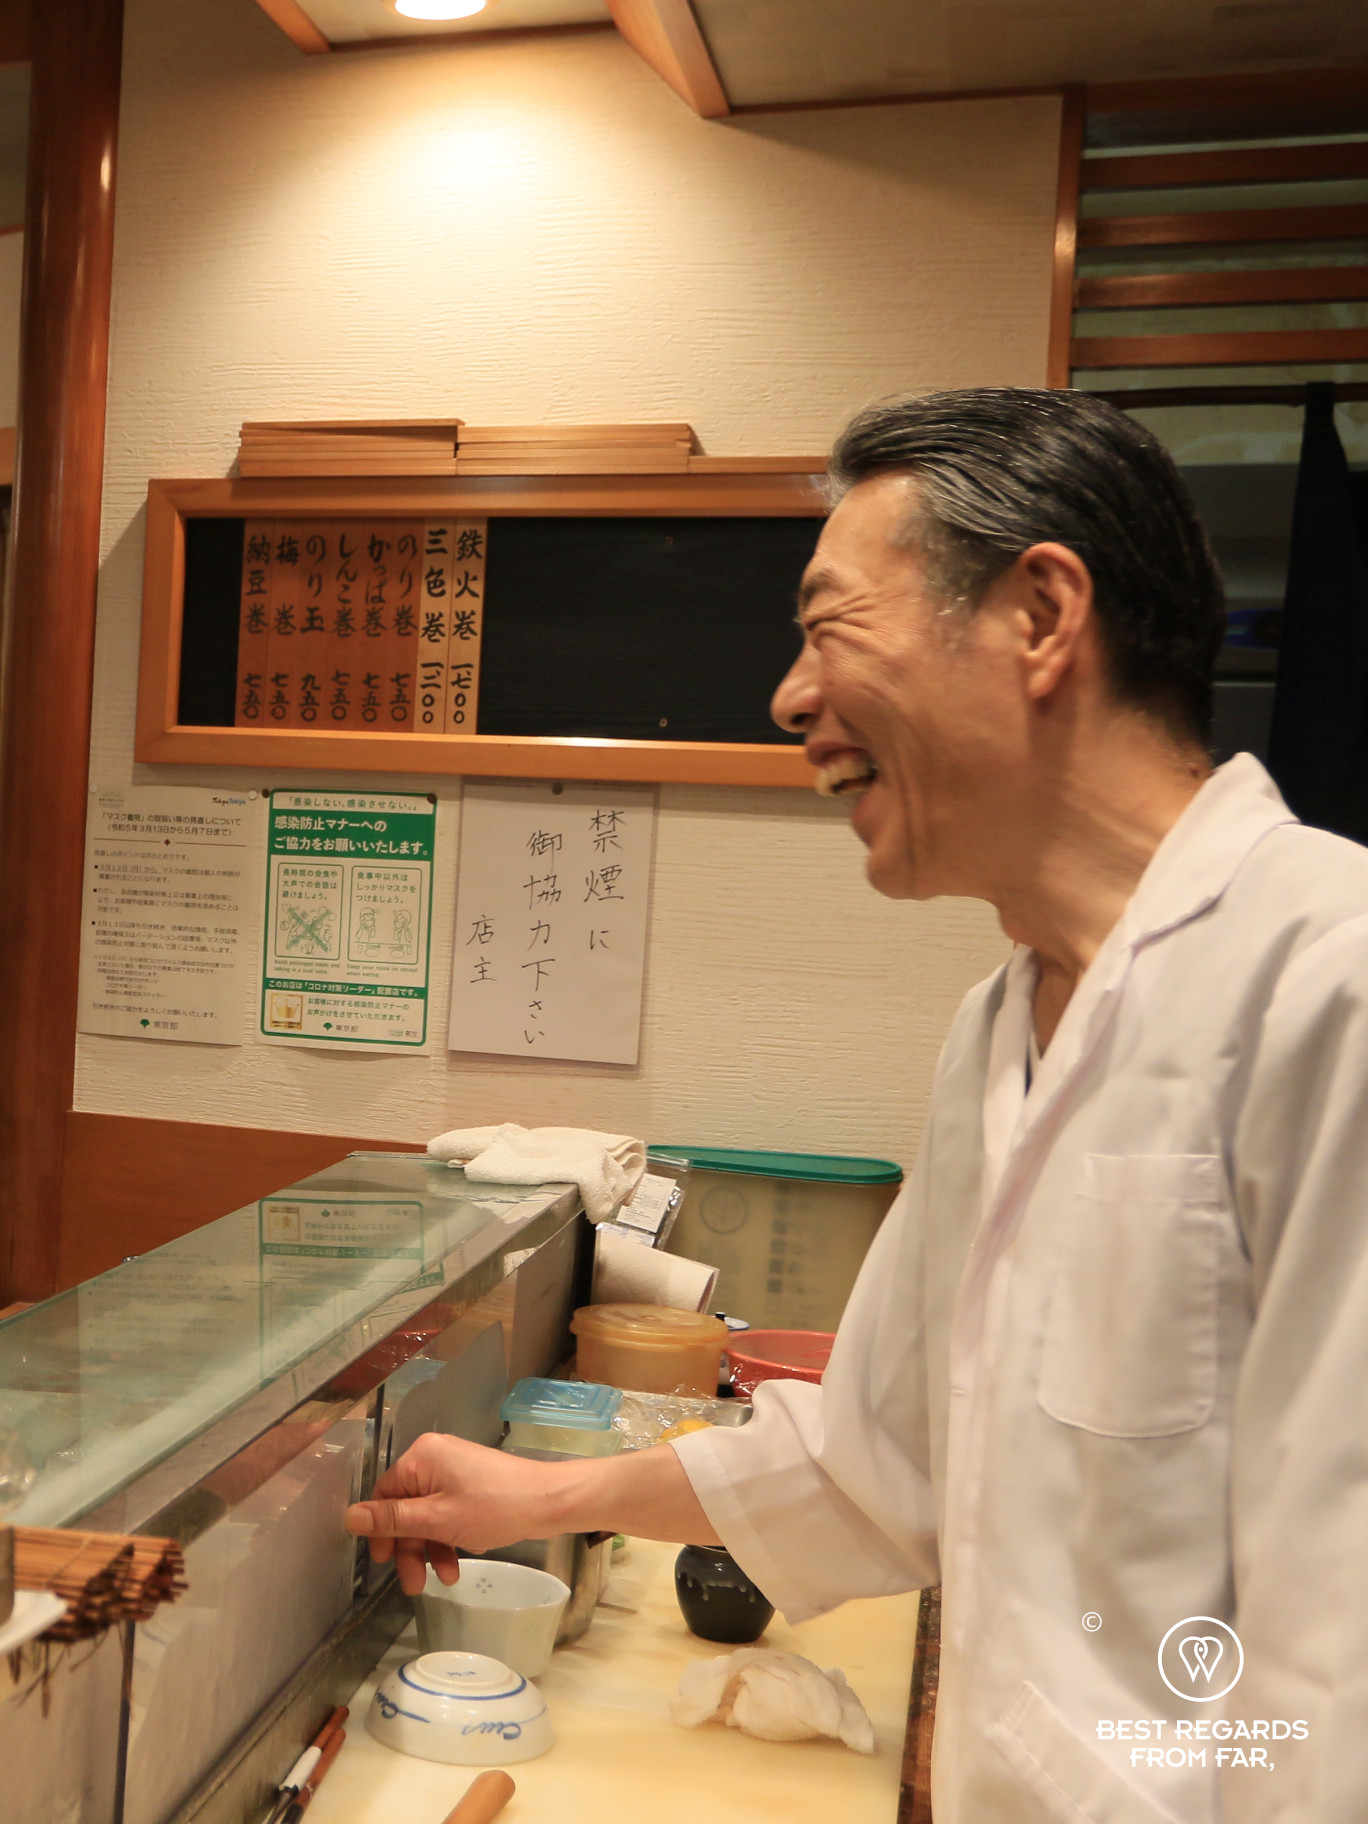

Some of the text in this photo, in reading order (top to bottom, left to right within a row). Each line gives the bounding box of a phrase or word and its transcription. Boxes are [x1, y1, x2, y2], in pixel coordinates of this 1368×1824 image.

[300, 534, 326, 634] のり玉
[332, 534, 358, 638] しんこ巻
[362, 534, 391, 637] かっぱ巻
[392, 534, 418, 636] のり巻
[420, 528, 448, 642] 三色巻
[452, 528, 483, 640] 鉄火巻
[274, 836, 428, 856] ご協力をお願いいたします。
[275, 815, 387, 832] 感染防止マナーへの
[282, 868, 338, 878] 長時間の会食や
[282, 880, 338, 890] 大声での会話は
[282, 891, 327, 901] 避けましょう。
[356, 883, 417, 894] しっかりマスクを
[356, 894, 404, 904] つけましょう。
[357, 871, 409, 882] 食事中以外は
[583, 809, 626, 950] 禁煙に
[465, 914, 497, 983] 店主
[521, 830, 563, 1044] 御協力下さい
